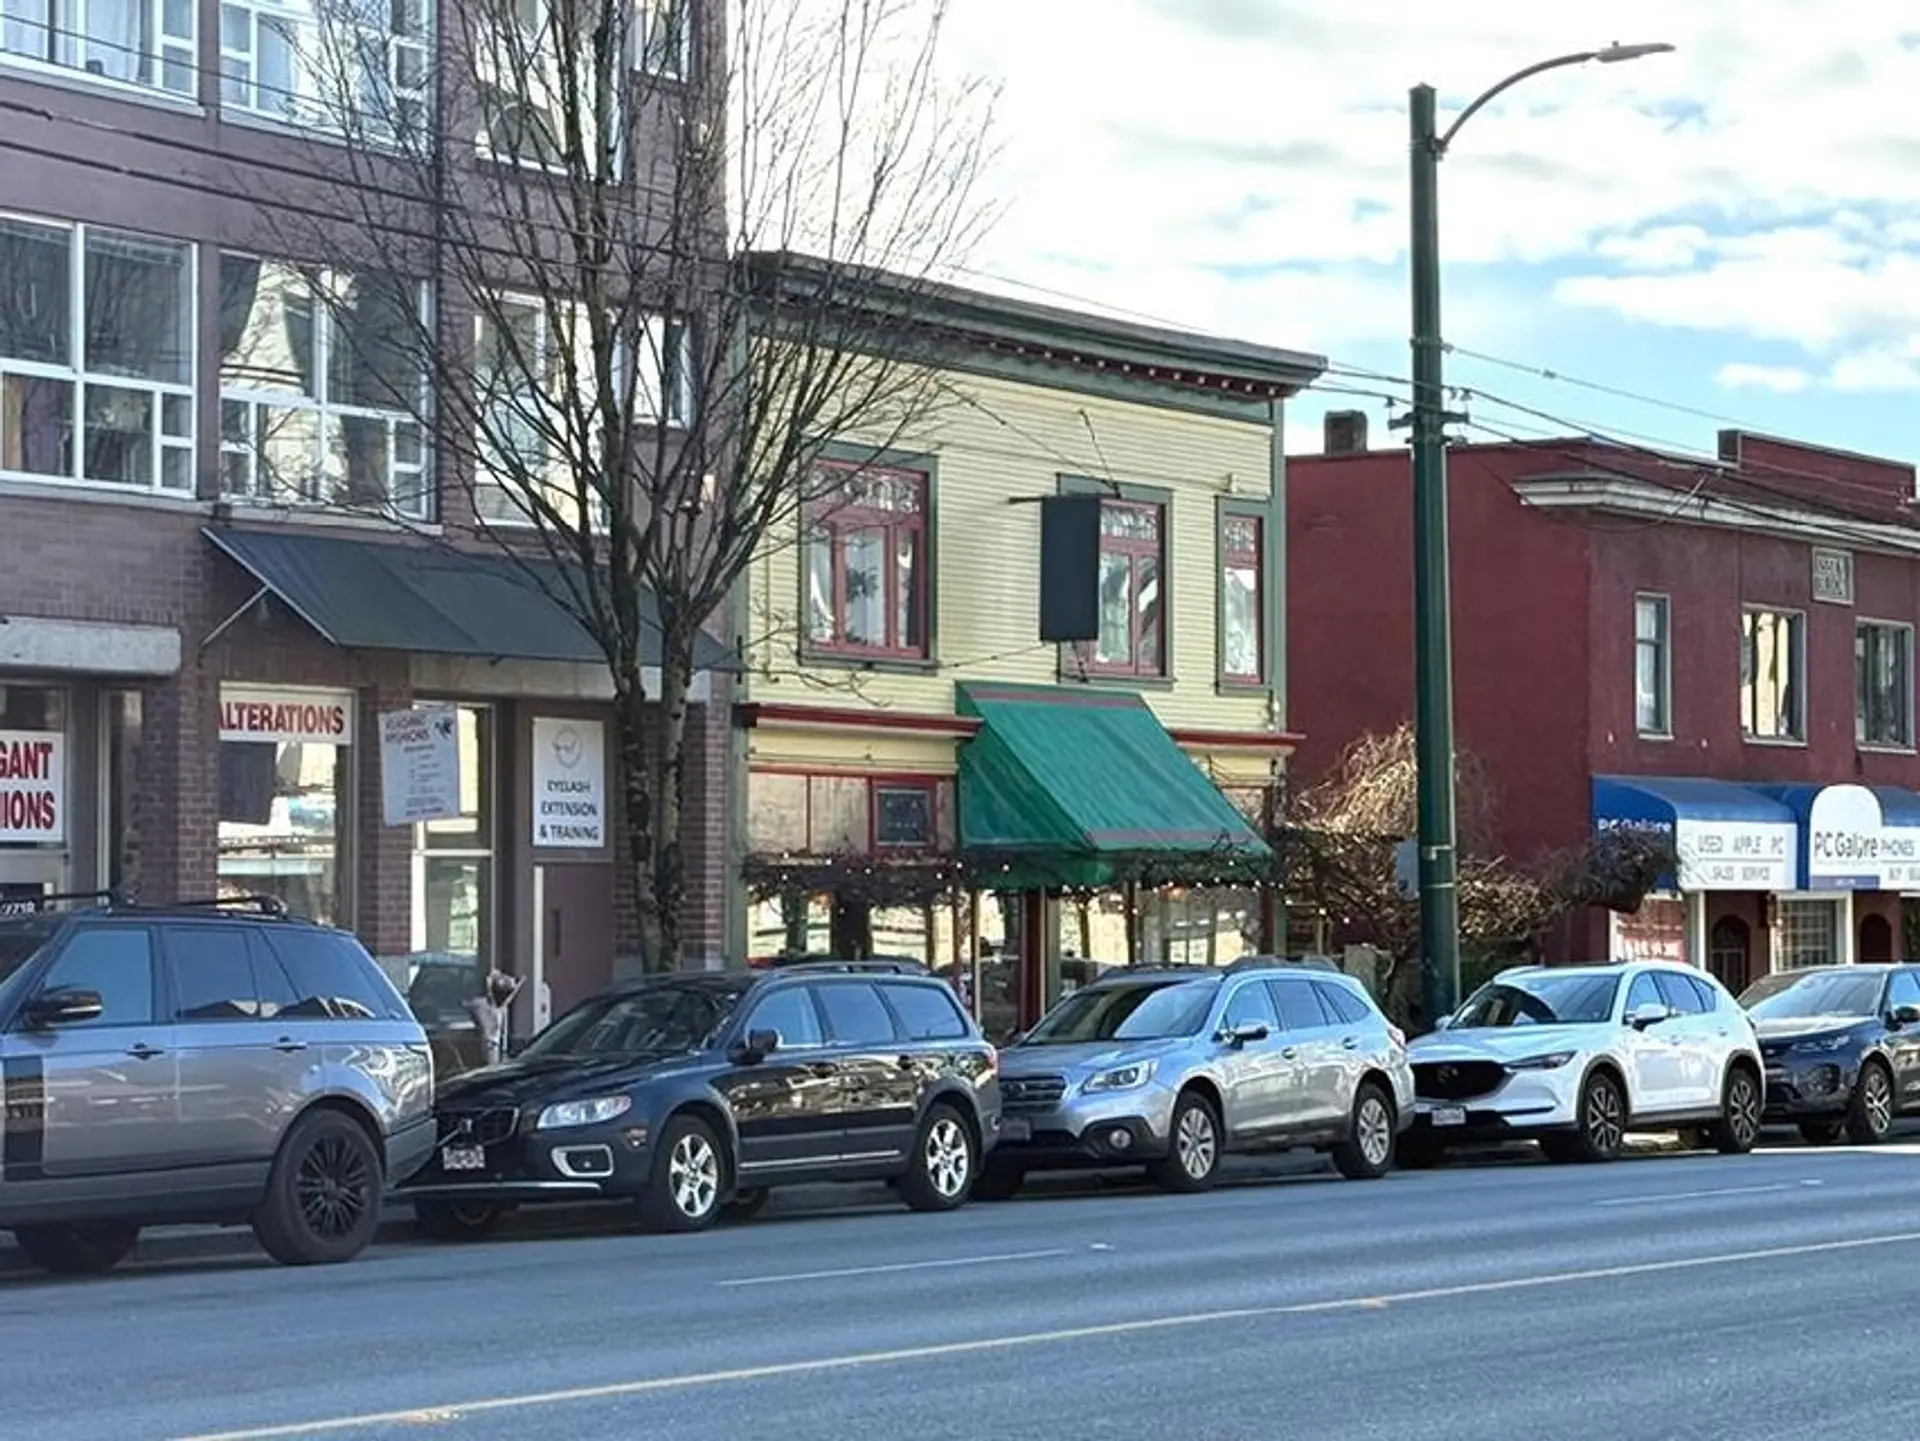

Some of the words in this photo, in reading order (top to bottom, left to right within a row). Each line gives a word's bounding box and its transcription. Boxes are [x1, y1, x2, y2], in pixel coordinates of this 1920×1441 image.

[547, 780, 591, 793] EYELASH
[0, 790, 55, 830] IONS
[541, 800, 598, 816] EXTENSION
[539, 824, 547, 838] &
[550, 825, 599, 840] TRAINING
[1814, 831, 1832, 857] PC
[1834, 830, 1879, 859] Galore
